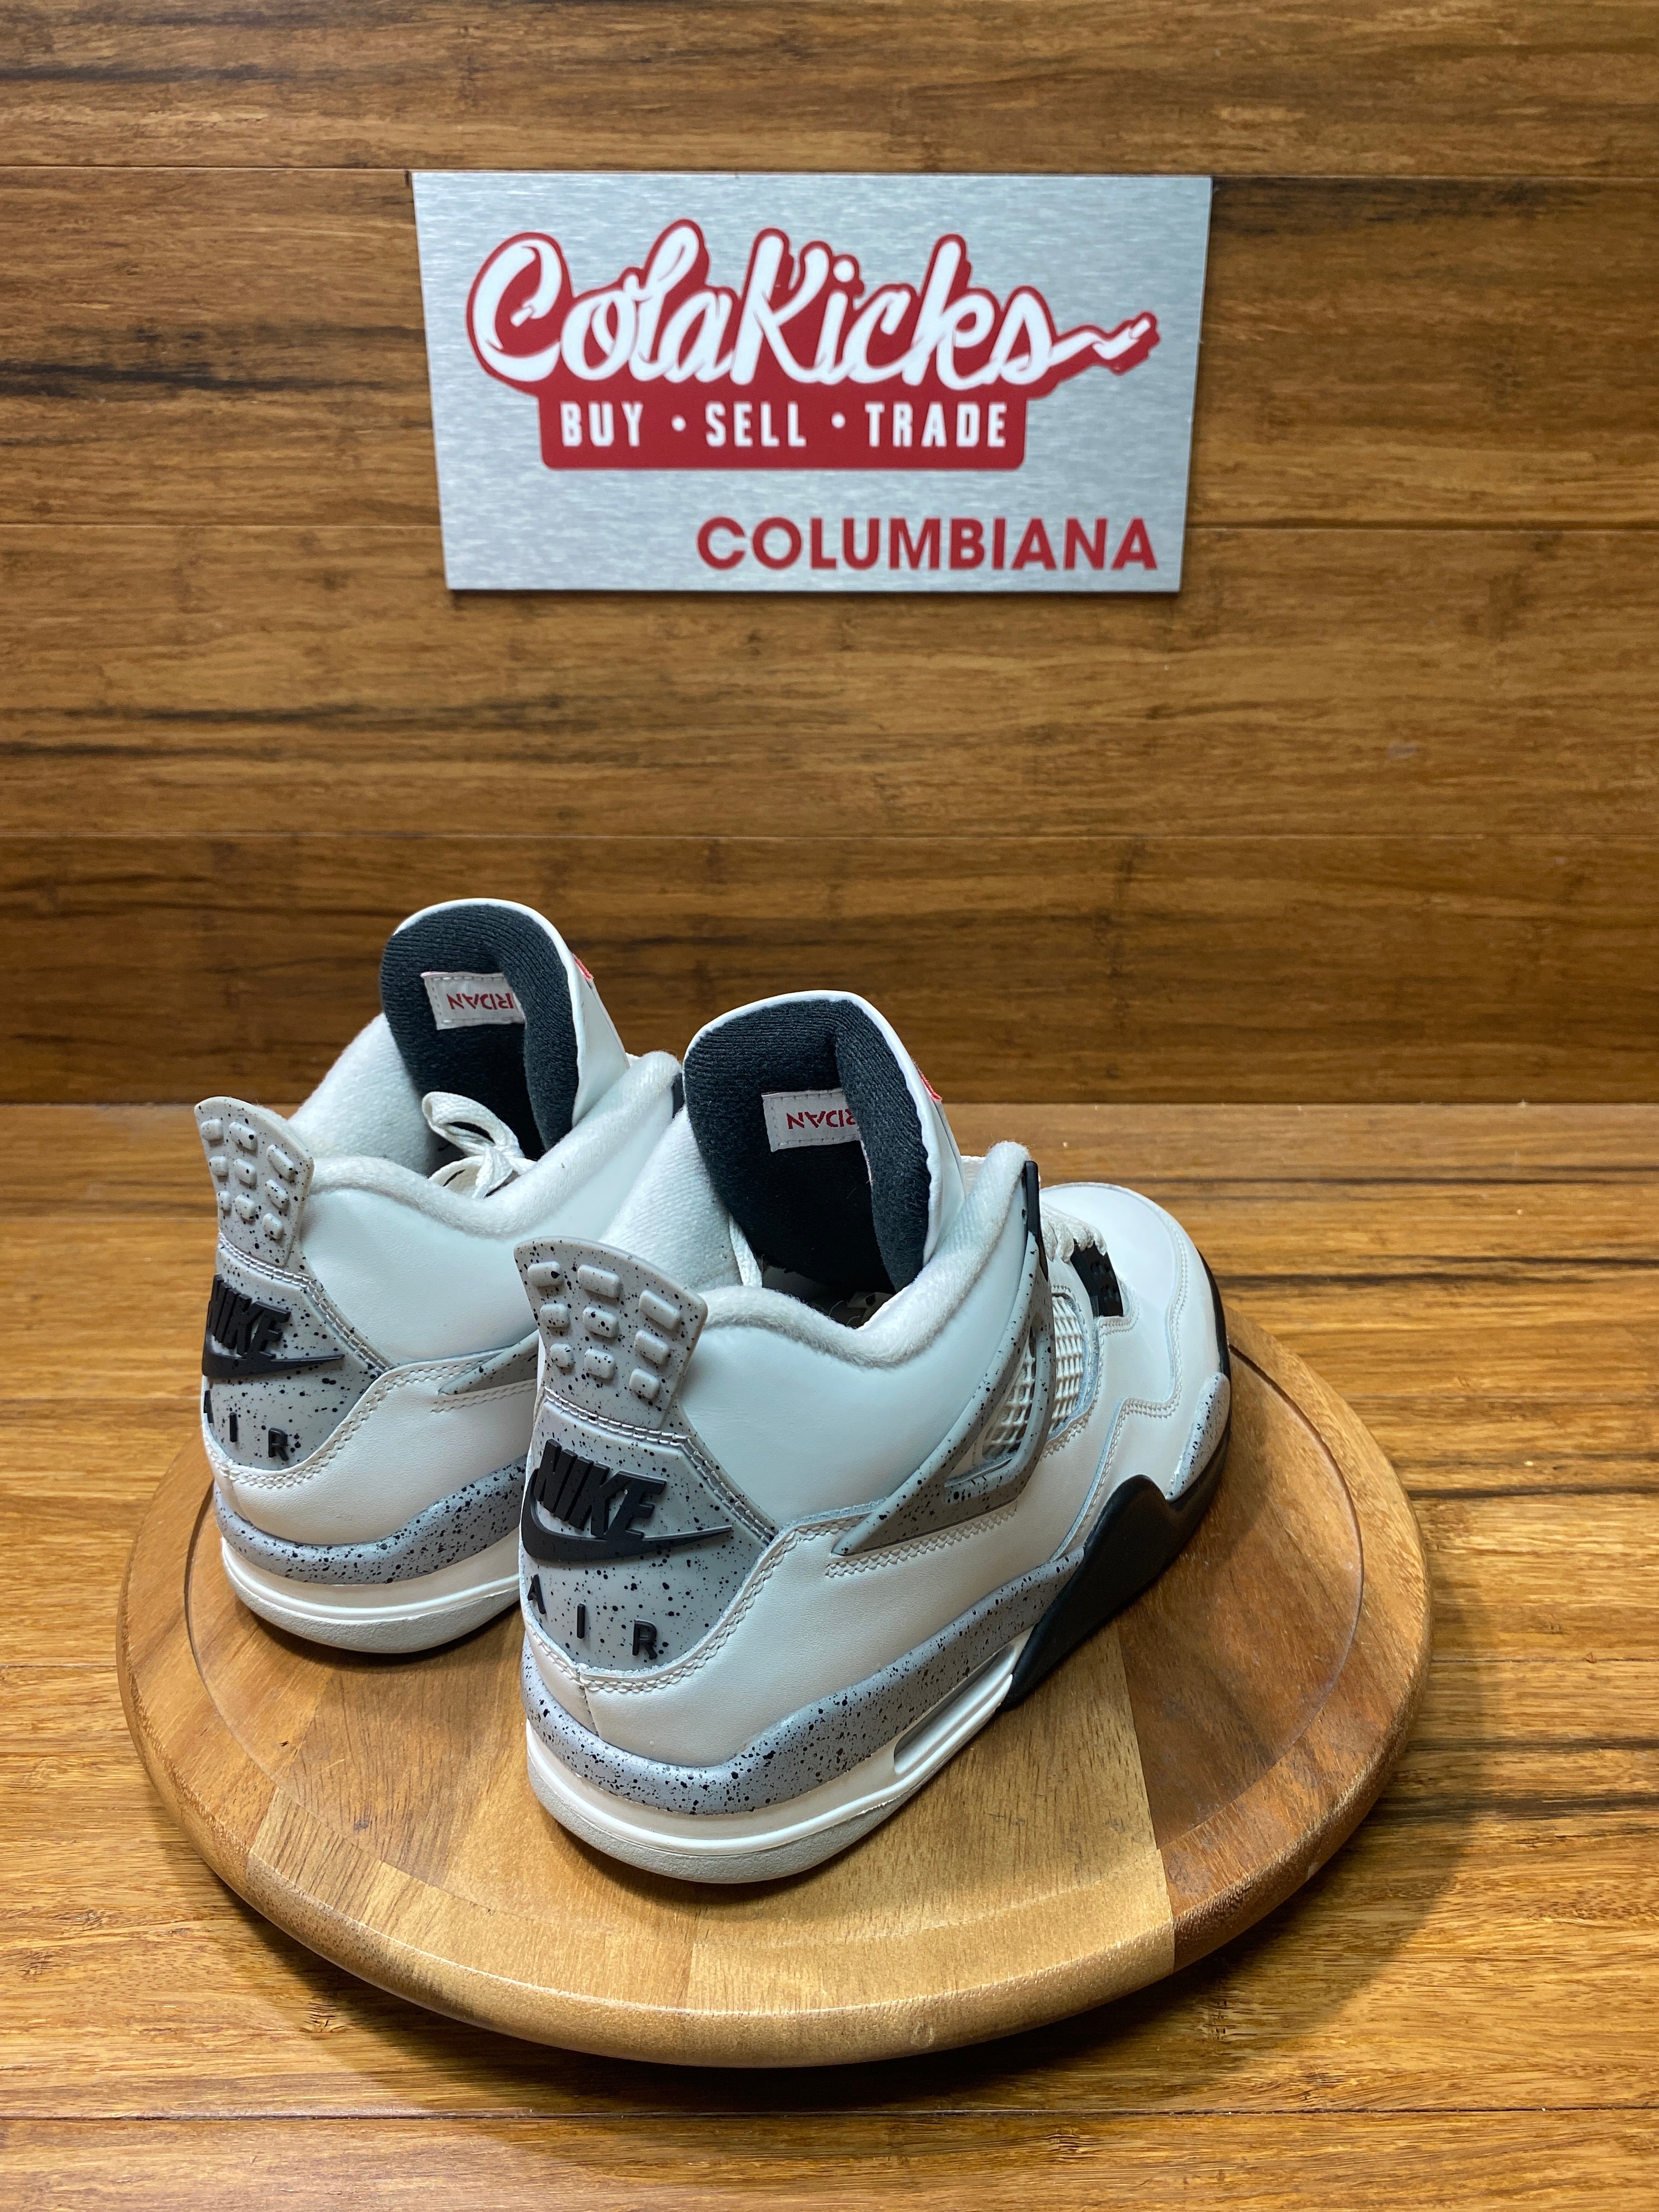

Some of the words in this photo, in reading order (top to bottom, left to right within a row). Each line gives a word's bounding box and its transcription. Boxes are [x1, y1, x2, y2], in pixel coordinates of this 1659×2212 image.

[561, 401, 645, 448] BUY
[706, 401, 807, 448] SELL
[864, 401, 1008, 448] TRADE
[696, 516, 1158, 571] COLUMBIANA
[447, 993, 514, 1010] RDAN
[533, 1438, 667, 1542] NIKE
[527, 1573, 658, 1660] AIR
